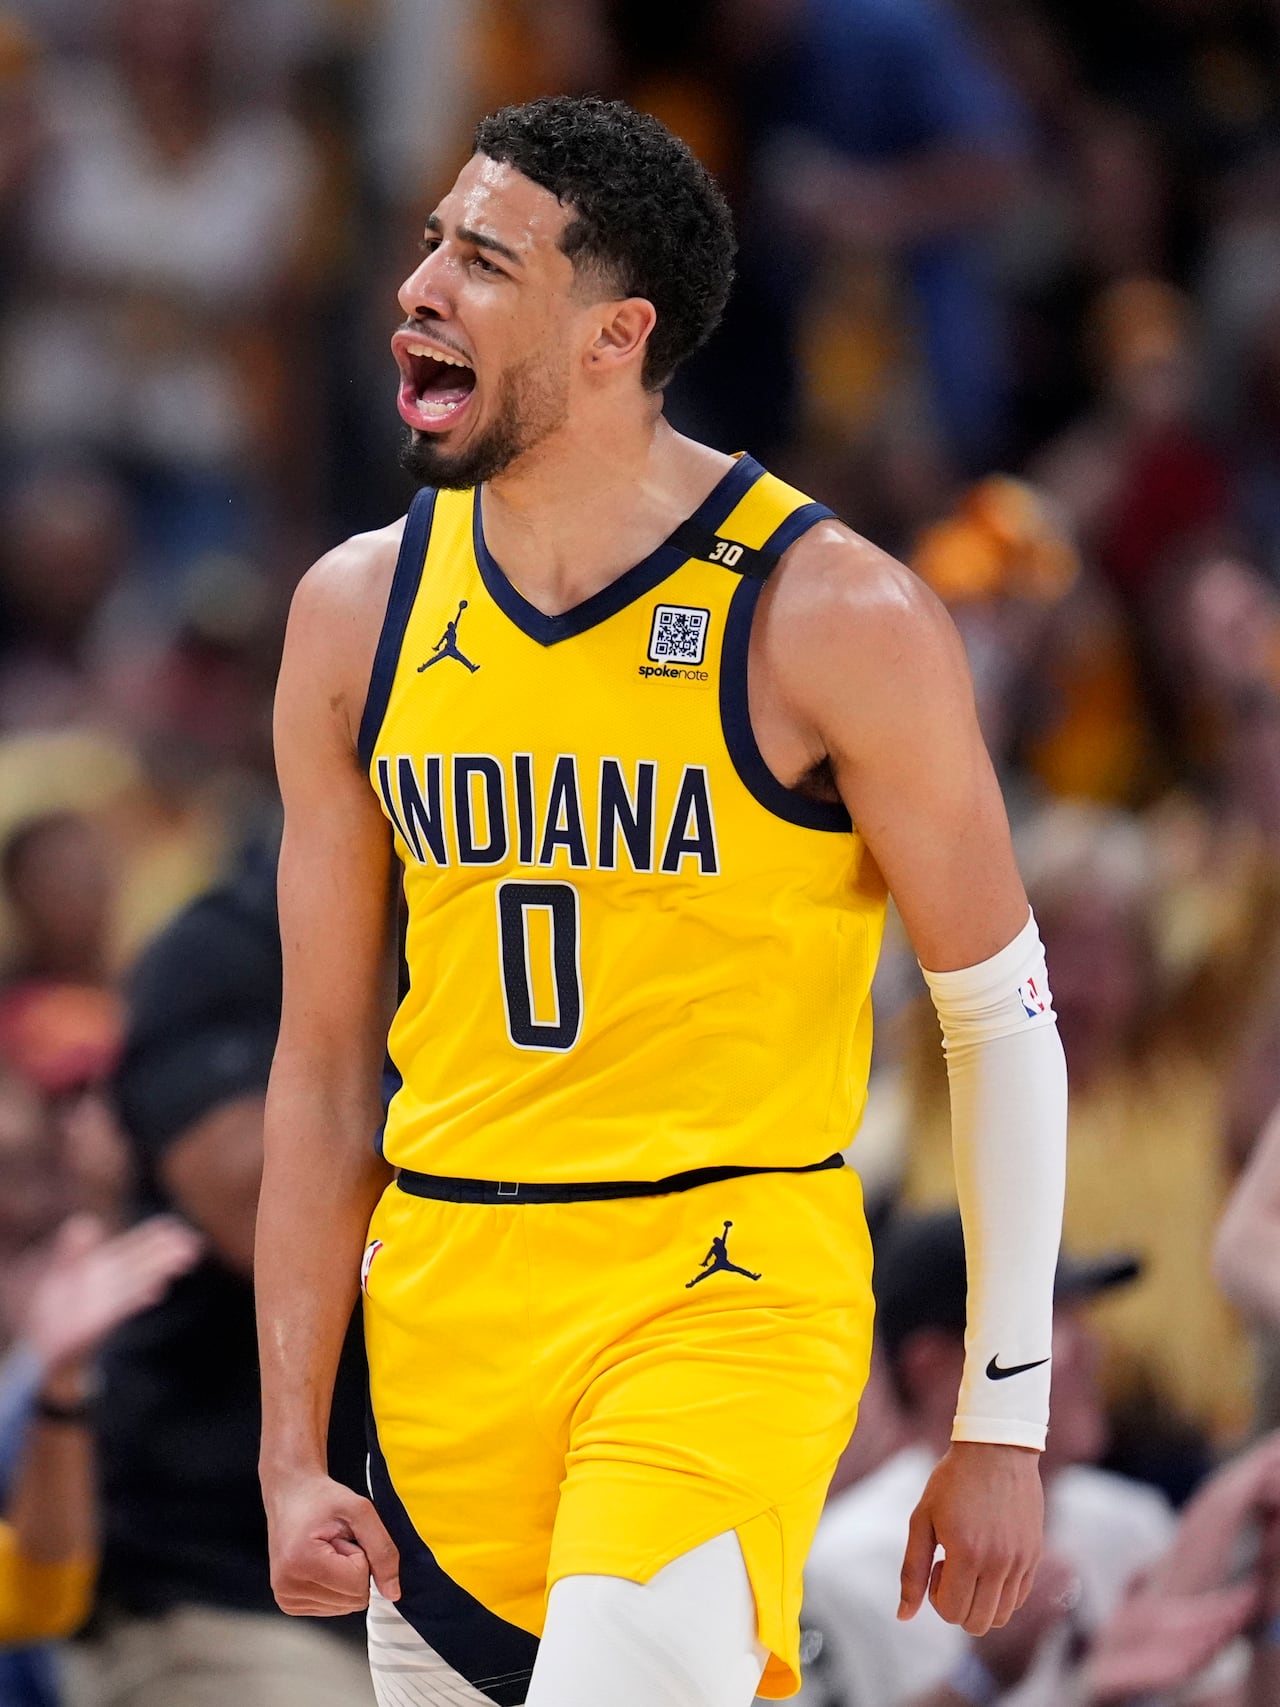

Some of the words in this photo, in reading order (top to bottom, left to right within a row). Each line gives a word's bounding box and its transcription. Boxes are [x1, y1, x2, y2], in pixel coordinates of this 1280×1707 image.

[709, 541, 744, 567] 30
[638, 664, 709, 681] spokenote
[376, 753, 720, 875] INDIANA
[496, 879, 581, 1053] 0
